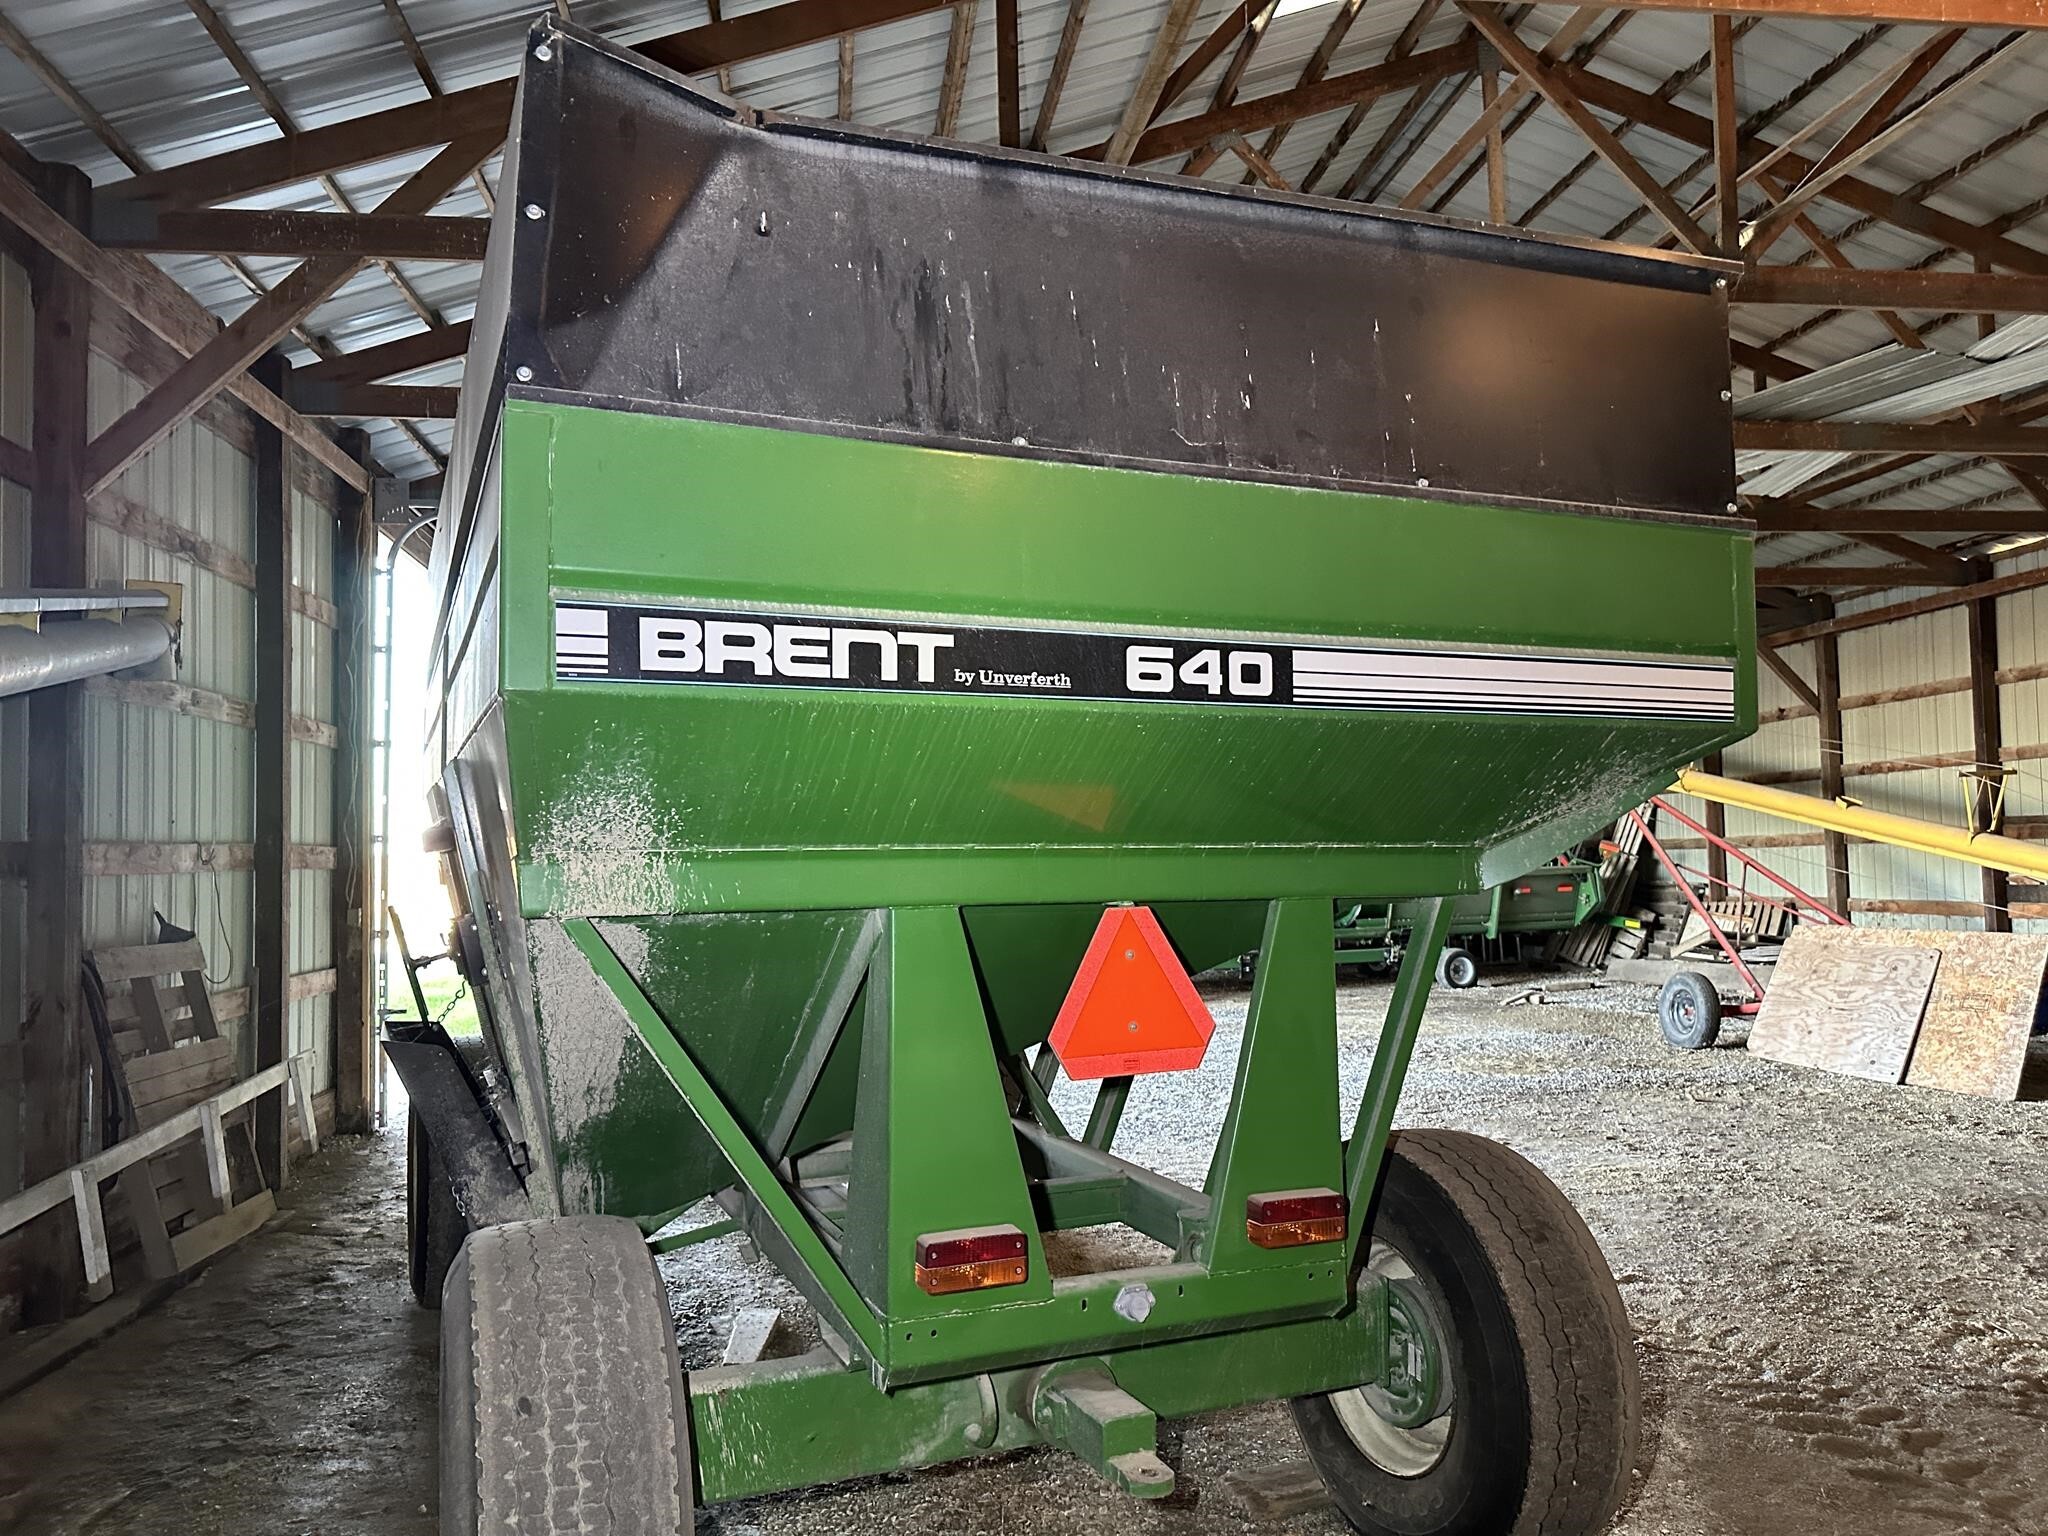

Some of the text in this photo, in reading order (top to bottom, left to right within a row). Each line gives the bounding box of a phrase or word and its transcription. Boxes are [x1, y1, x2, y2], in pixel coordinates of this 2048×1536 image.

[638, 616, 1273, 697] BRENT by Unverferth 640
